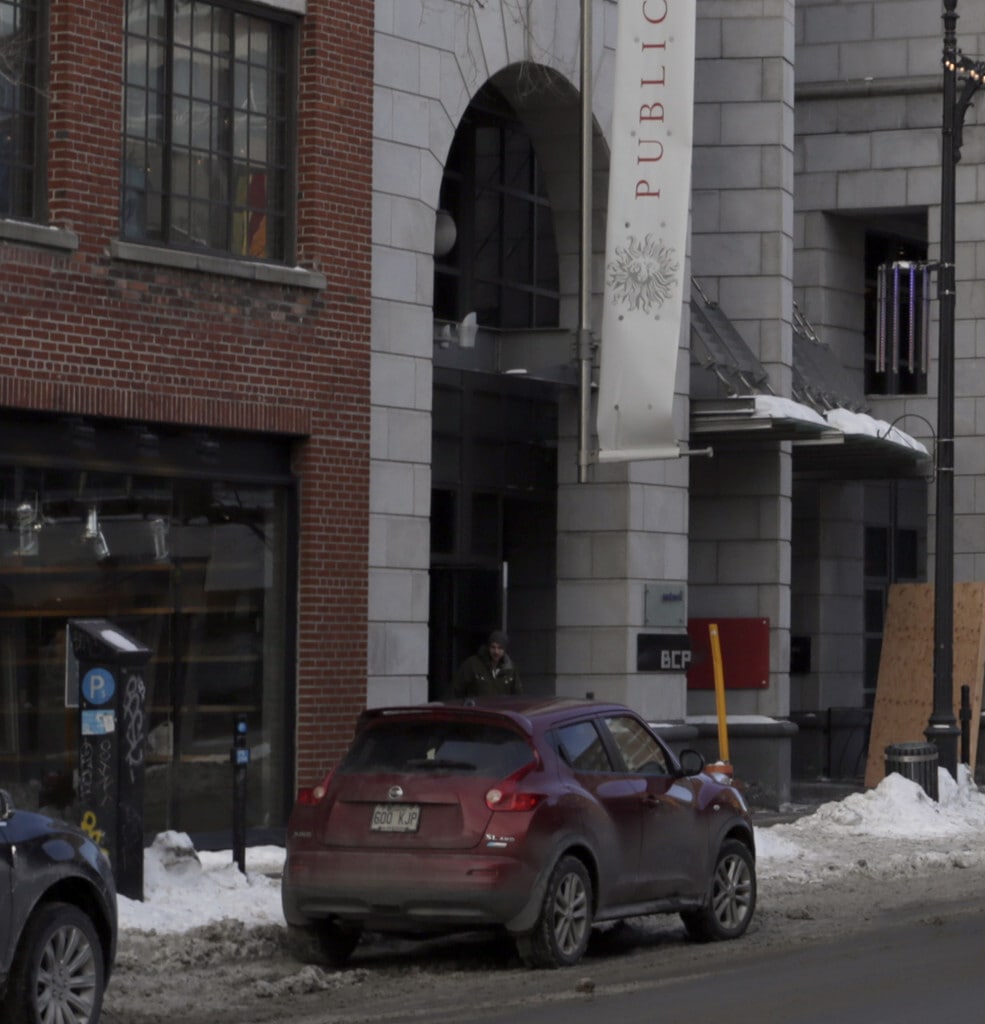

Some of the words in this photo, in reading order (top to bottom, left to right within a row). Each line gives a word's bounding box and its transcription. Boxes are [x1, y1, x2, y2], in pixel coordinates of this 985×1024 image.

[660, 649, 693, 670] BCP
[373, 810, 393, 825] 600
[398, 810, 417, 825] KJP
